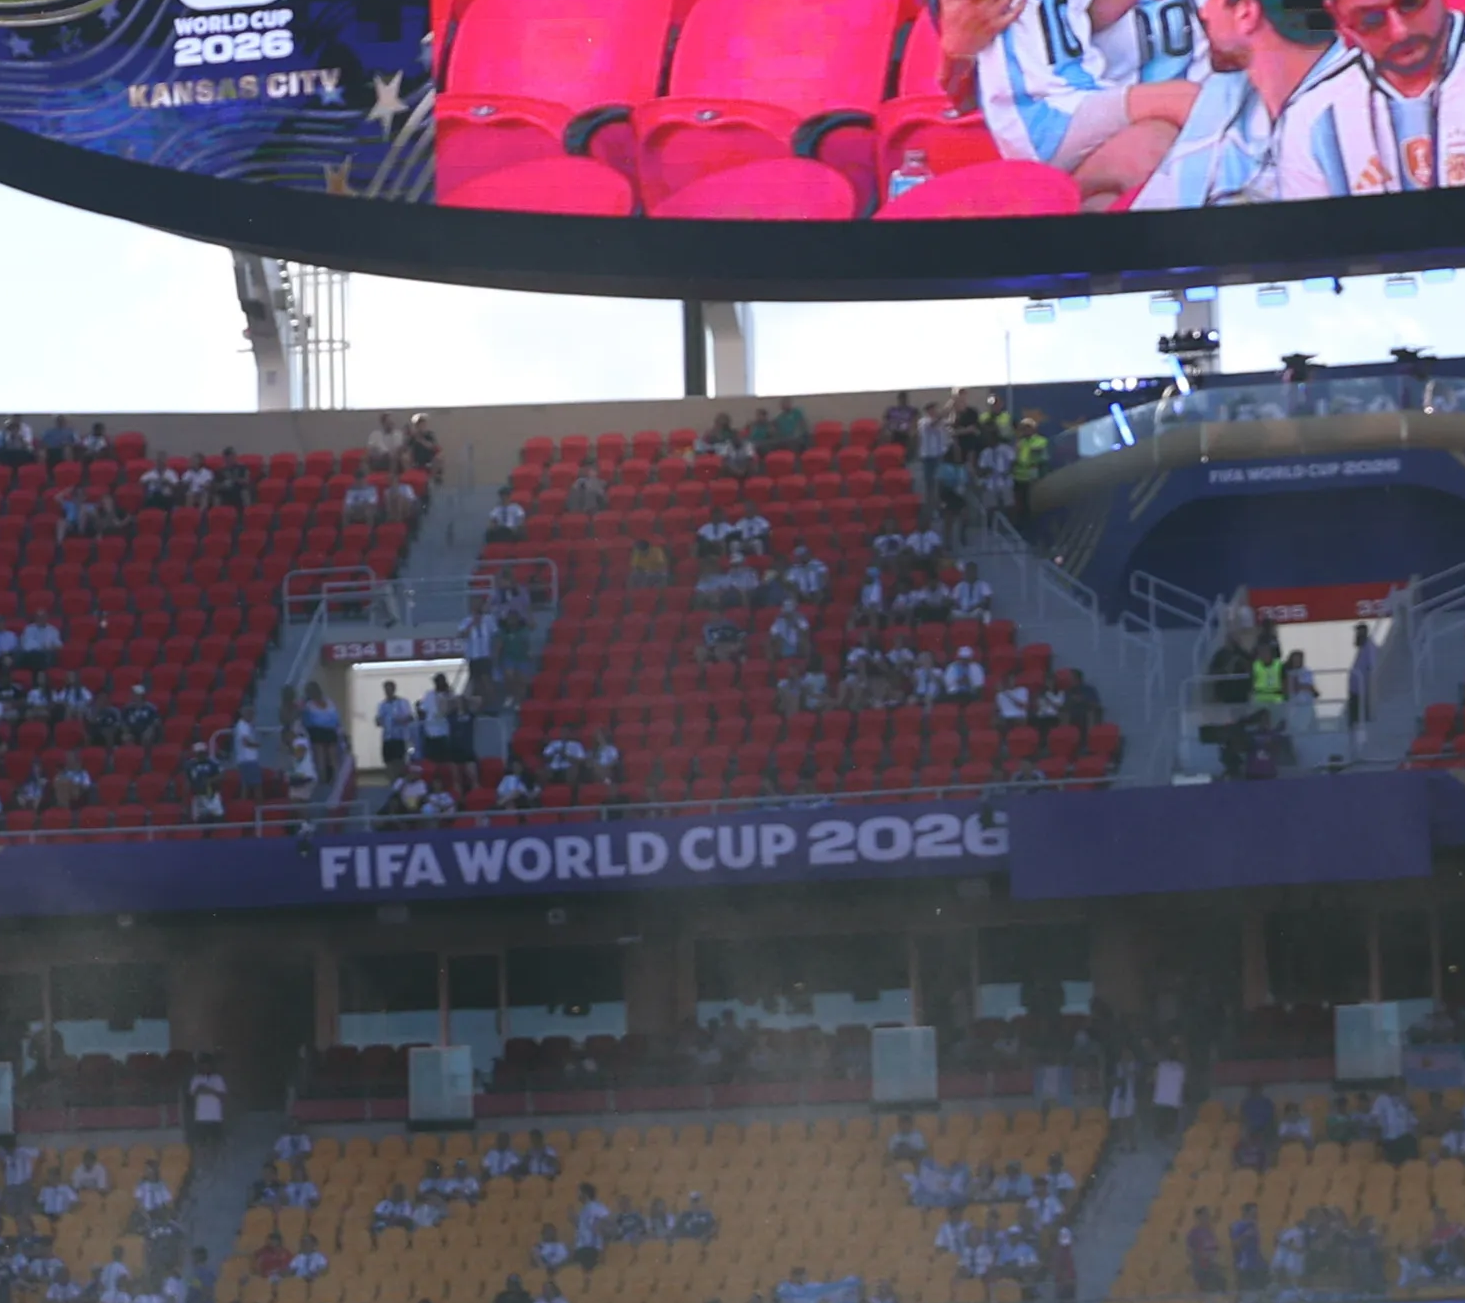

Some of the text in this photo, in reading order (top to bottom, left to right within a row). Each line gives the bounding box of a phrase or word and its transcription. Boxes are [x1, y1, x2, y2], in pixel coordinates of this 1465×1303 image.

[174, 8, 292, 36] WORLD CUP
[174, 31, 293, 67] 2026
[128, 68, 341, 110] KANSAS CITY
[1209, 458, 1401, 484] FIFA WORLD CUP 2026
[333, 642, 377, 659] 334
[319, 812, 1010, 890] FIFA WORLD CUP 2026
